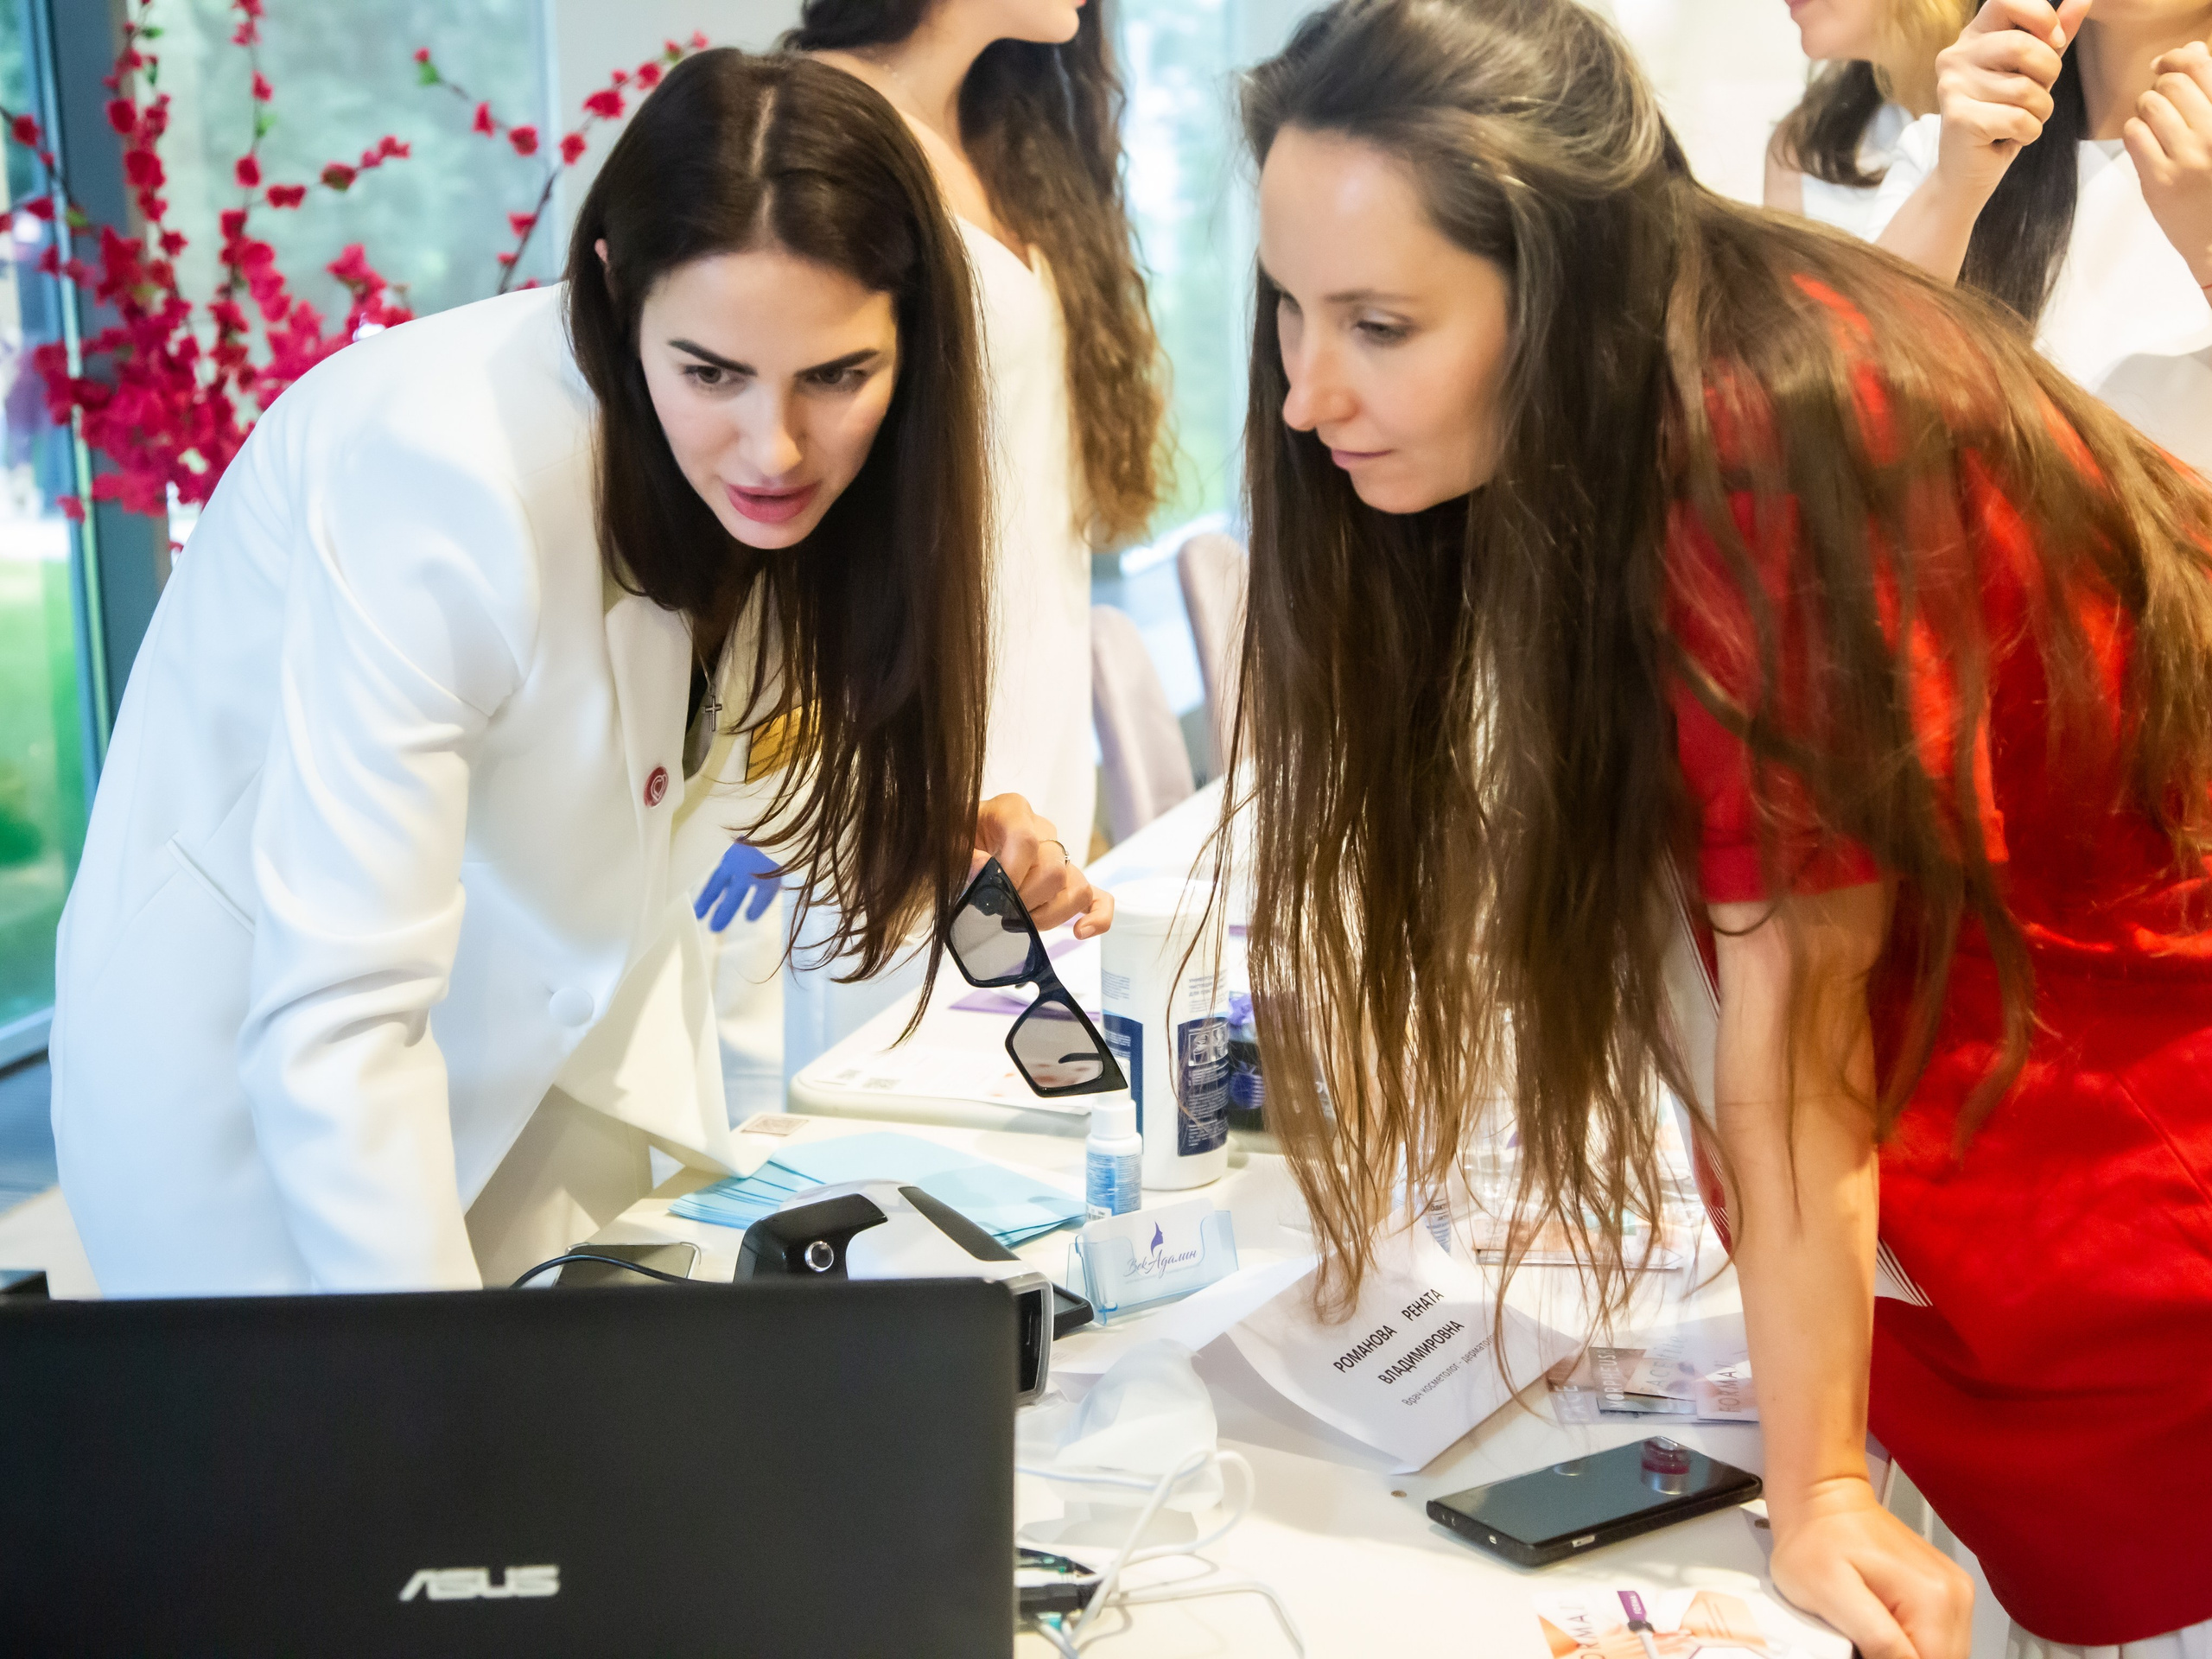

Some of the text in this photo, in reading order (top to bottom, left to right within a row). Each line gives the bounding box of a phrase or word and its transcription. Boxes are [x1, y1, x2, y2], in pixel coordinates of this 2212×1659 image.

[1333, 1288, 1445, 1374] РОМАНОВА РЕНАТА
[1377, 1319, 1465, 1385] ВЛАДИМИРОВНА
[1402, 1392, 1425, 1407] Врач
[1421, 1363, 1460, 1395] косметолог
[1462, 1333, 1495, 1364] дерматоло
[399, 1563, 561, 1601] ASUS
